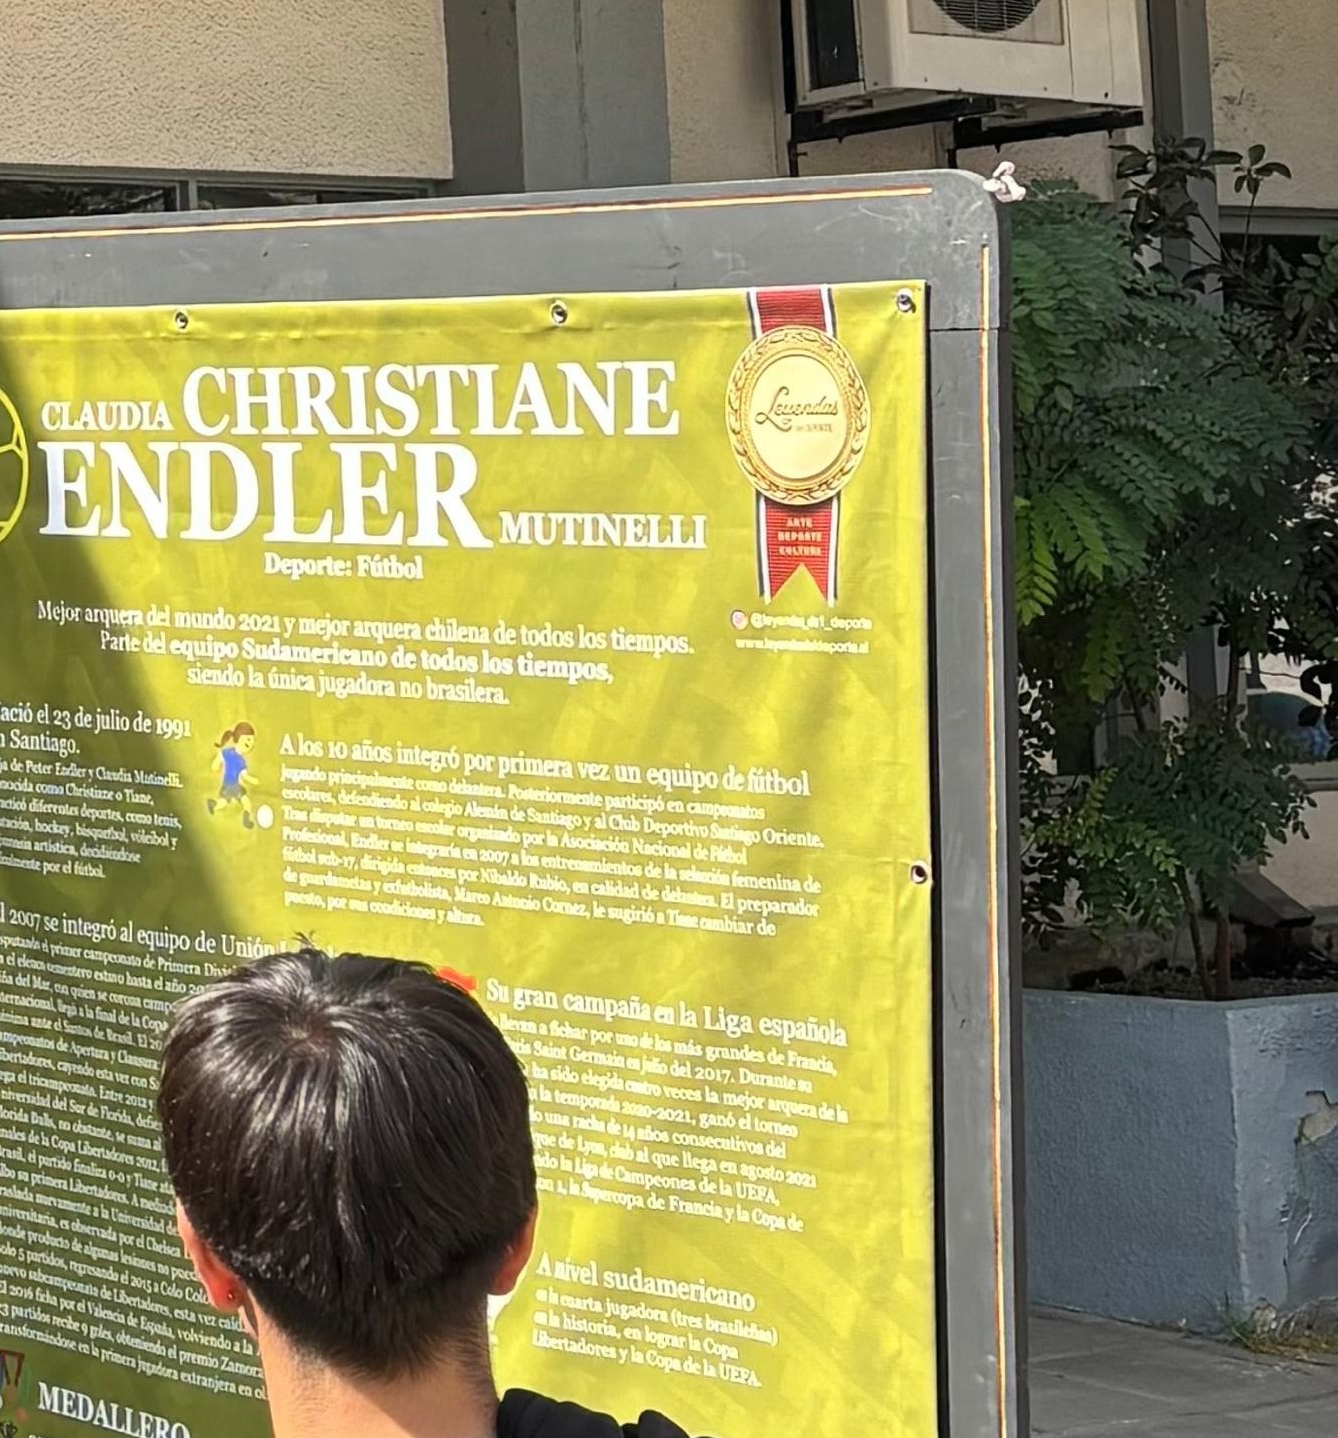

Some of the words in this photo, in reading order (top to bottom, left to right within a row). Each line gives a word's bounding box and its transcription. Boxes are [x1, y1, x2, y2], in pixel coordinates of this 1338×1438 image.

[41, 401, 174, 431] CLAUDIA
[182, 361, 679, 437] CHRISTIANE
[38, 441, 494, 549] ENDLER
[499, 511, 707, 549] MUTINELLI
[786, 517, 812, 528] ARTE
[264, 552, 352, 581] Deporte:
[357, 554, 423, 580] Fútbol
[37, 600, 81, 626] Mejor
[85, 606, 143, 629] arquera
[146, 604, 171, 628] del
[174, 607, 235, 631] mundo
[239, 611, 281, 633] 2021
[283, 616, 295, 638] y
[298, 612, 350, 640] mejor
[354, 621, 421, 643] arquera
[425, 618, 490, 644] chilena
[494, 619, 517, 646] de
[521, 621, 574, 648] todos
[578, 625, 607, 649] los
[611, 628, 695, 659] tiempos.
[101, 631, 141, 652] Parte
[142, 632, 167, 655] del
[170, 634, 239, 663] equipo
[242, 638, 387, 668] Sudamericano
[391, 645, 417, 670] de
[421, 647, 478, 672] todos
[482, 650, 514, 675] los
[517, 652, 613, 685] tiempos,
[187, 662, 245, 687] siendo
[248, 664, 265, 688] la
[268, 668, 315, 692] única
[317, 671, 394, 698] jugadora
[400, 682, 422, 699] no
[427, 676, 510, 705] brasilera.
[10, 728, 81, 758] Santiago.
[37, 703, 49, 724] el
[53, 710, 71, 731] 23
[75, 706, 92, 728] de
[95, 708, 130, 734] julio
[133, 711, 152, 734] de
[155, 719, 191, 740] 1991
[11, 758, 23, 773] de
[25, 761, 53, 776] Peter
[279, 733, 295, 756] A
[297, 733, 324, 758] los
[327, 741, 347, 760] 10
[351, 740, 393, 764] años
[397, 741, 460, 772] integró
[464, 752, 493, 775] por
[498, 751, 573, 780] primera
[577, 761, 611, 782] vez
[614, 764, 641, 784] un
[647, 763, 719, 794] equipo
[723, 765, 745, 792] de
[747, 767, 811, 796] fútbol
[803, 876, 821, 894] de
[9, 909, 40, 933] 2007
[44, 918, 59, 932] se
[62, 913, 116, 944] integró
[120, 920, 133, 944] al
[137, 923, 190, 956] equipo
[194, 930, 216, 953] de
[757, 918, 777, 936] de
[486, 978, 510, 1005] Su
[512, 983, 558, 1013] gran
[562, 990, 651, 1025] campaña
[653, 1005, 674, 1025] en
[679, 1000, 699, 1028] la
[702, 1005, 754, 1039] Liga
[758, 1016, 848, 1048] española
[767, 1047, 786, 1065] de
[535, 1251, 552, 1276] A
[555, 1257, 599, 1288] nivel
[603, 1267, 755, 1312] sudamericano
